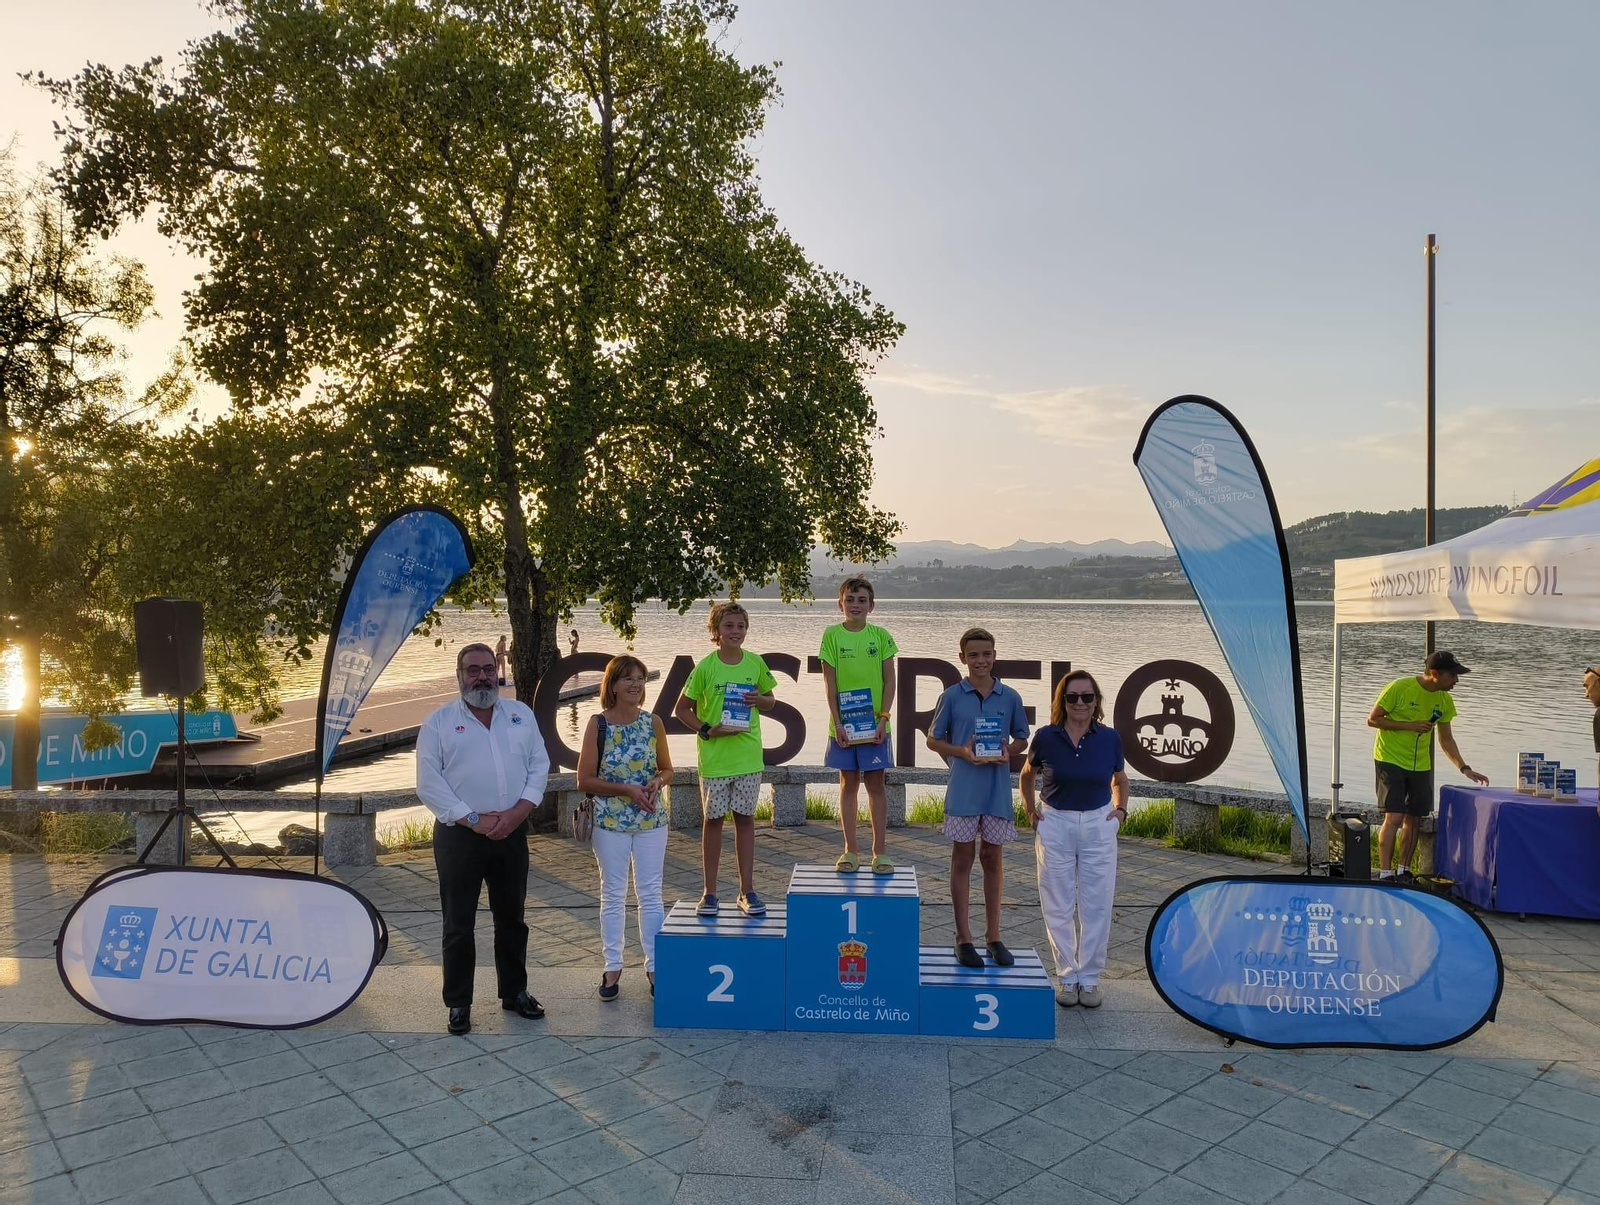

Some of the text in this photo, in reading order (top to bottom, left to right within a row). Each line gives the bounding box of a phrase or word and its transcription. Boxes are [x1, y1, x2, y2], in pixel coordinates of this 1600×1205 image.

[1141, 737, 1204, 755] DE MIÑO
[164, 915, 272, 946] XUNTA
[841, 901, 857, 934] 1
[155, 948, 331, 983] DE GALICIA
[706, 964, 735, 1002] 2
[1243, 968, 1401, 993] DEPUTACIÓN
[795, 1006, 910, 1021] Castrelo de Miño
[818, 994, 886, 1007] Concello de
[973, 993, 1000, 1031] 3
[1266, 994, 1382, 1017] OURENSE
